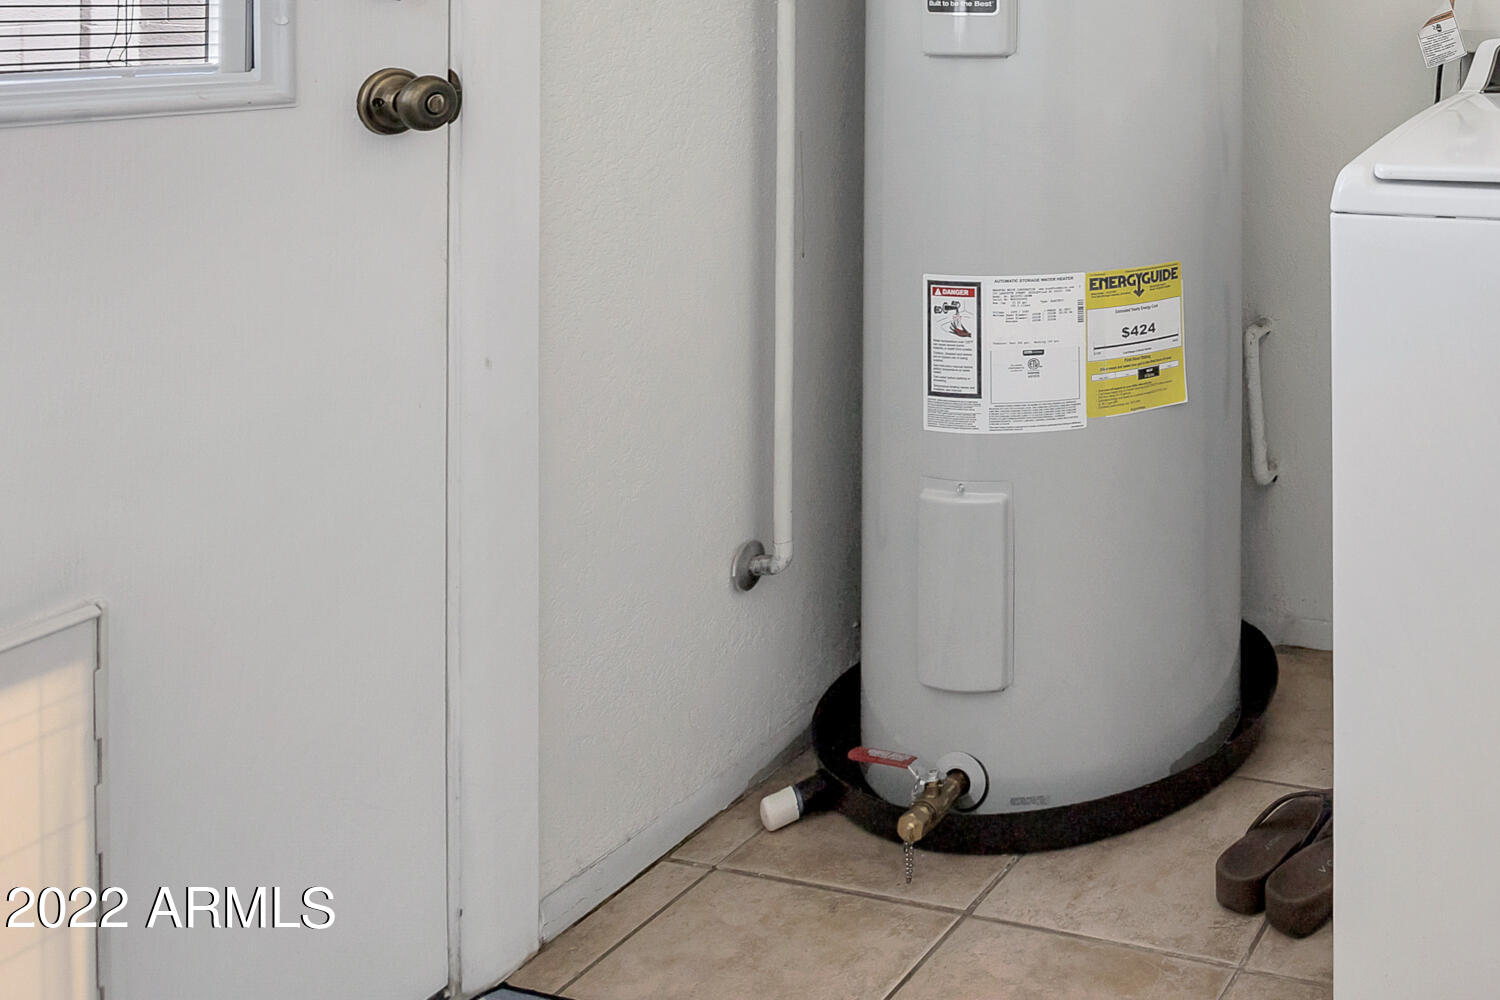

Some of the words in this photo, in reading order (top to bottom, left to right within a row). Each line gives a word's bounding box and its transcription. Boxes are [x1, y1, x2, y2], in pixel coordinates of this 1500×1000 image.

[1089, 266, 1179, 295] ENERGYGUIDE
[941, 288, 969, 296] DANGER
[1121, 322, 1156, 339] $424
